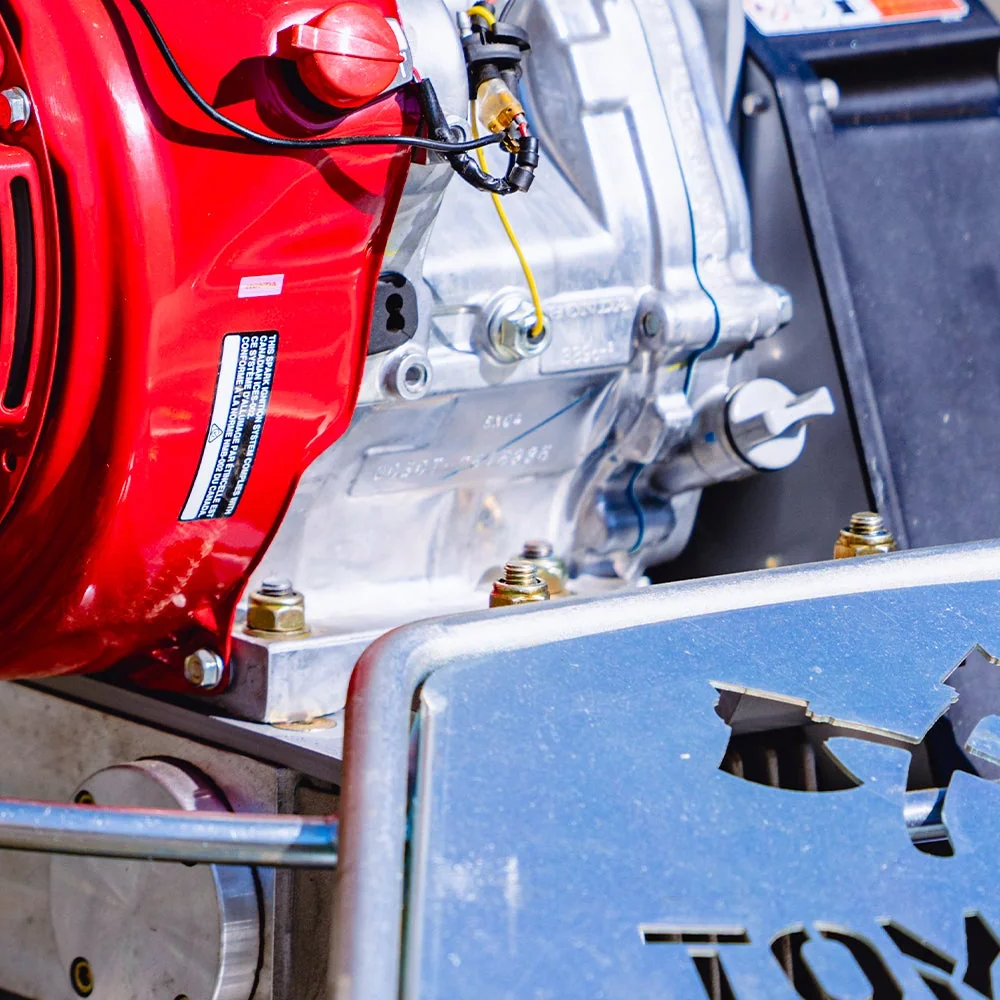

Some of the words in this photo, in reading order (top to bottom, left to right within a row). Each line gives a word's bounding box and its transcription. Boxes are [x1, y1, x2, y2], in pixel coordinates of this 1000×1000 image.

[250, 336, 259, 348] CE
[267, 334, 277, 355] THIS
[236, 337, 250, 386] CONFORME
[244, 349, 258, 390] SYSTÈME
[254, 335, 268, 380] CANADIAN
[262, 356, 274, 386] SPARK
[232, 395, 241, 407] LA
[256, 387, 270, 423] IGNITION
[225, 408, 238, 438] NORME
[215, 438, 231, 472] NMB-002
[227, 445, 239, 463] PAR
[246, 424, 261, 457] SYSTEM
[211, 473, 222, 485] DU
[212, 463, 234, 504] ÉTINCELLE
[232, 458, 252, 496] COMPLIES
[206, 504, 218, 518] EST
[224, 496, 239, 515] WITH
